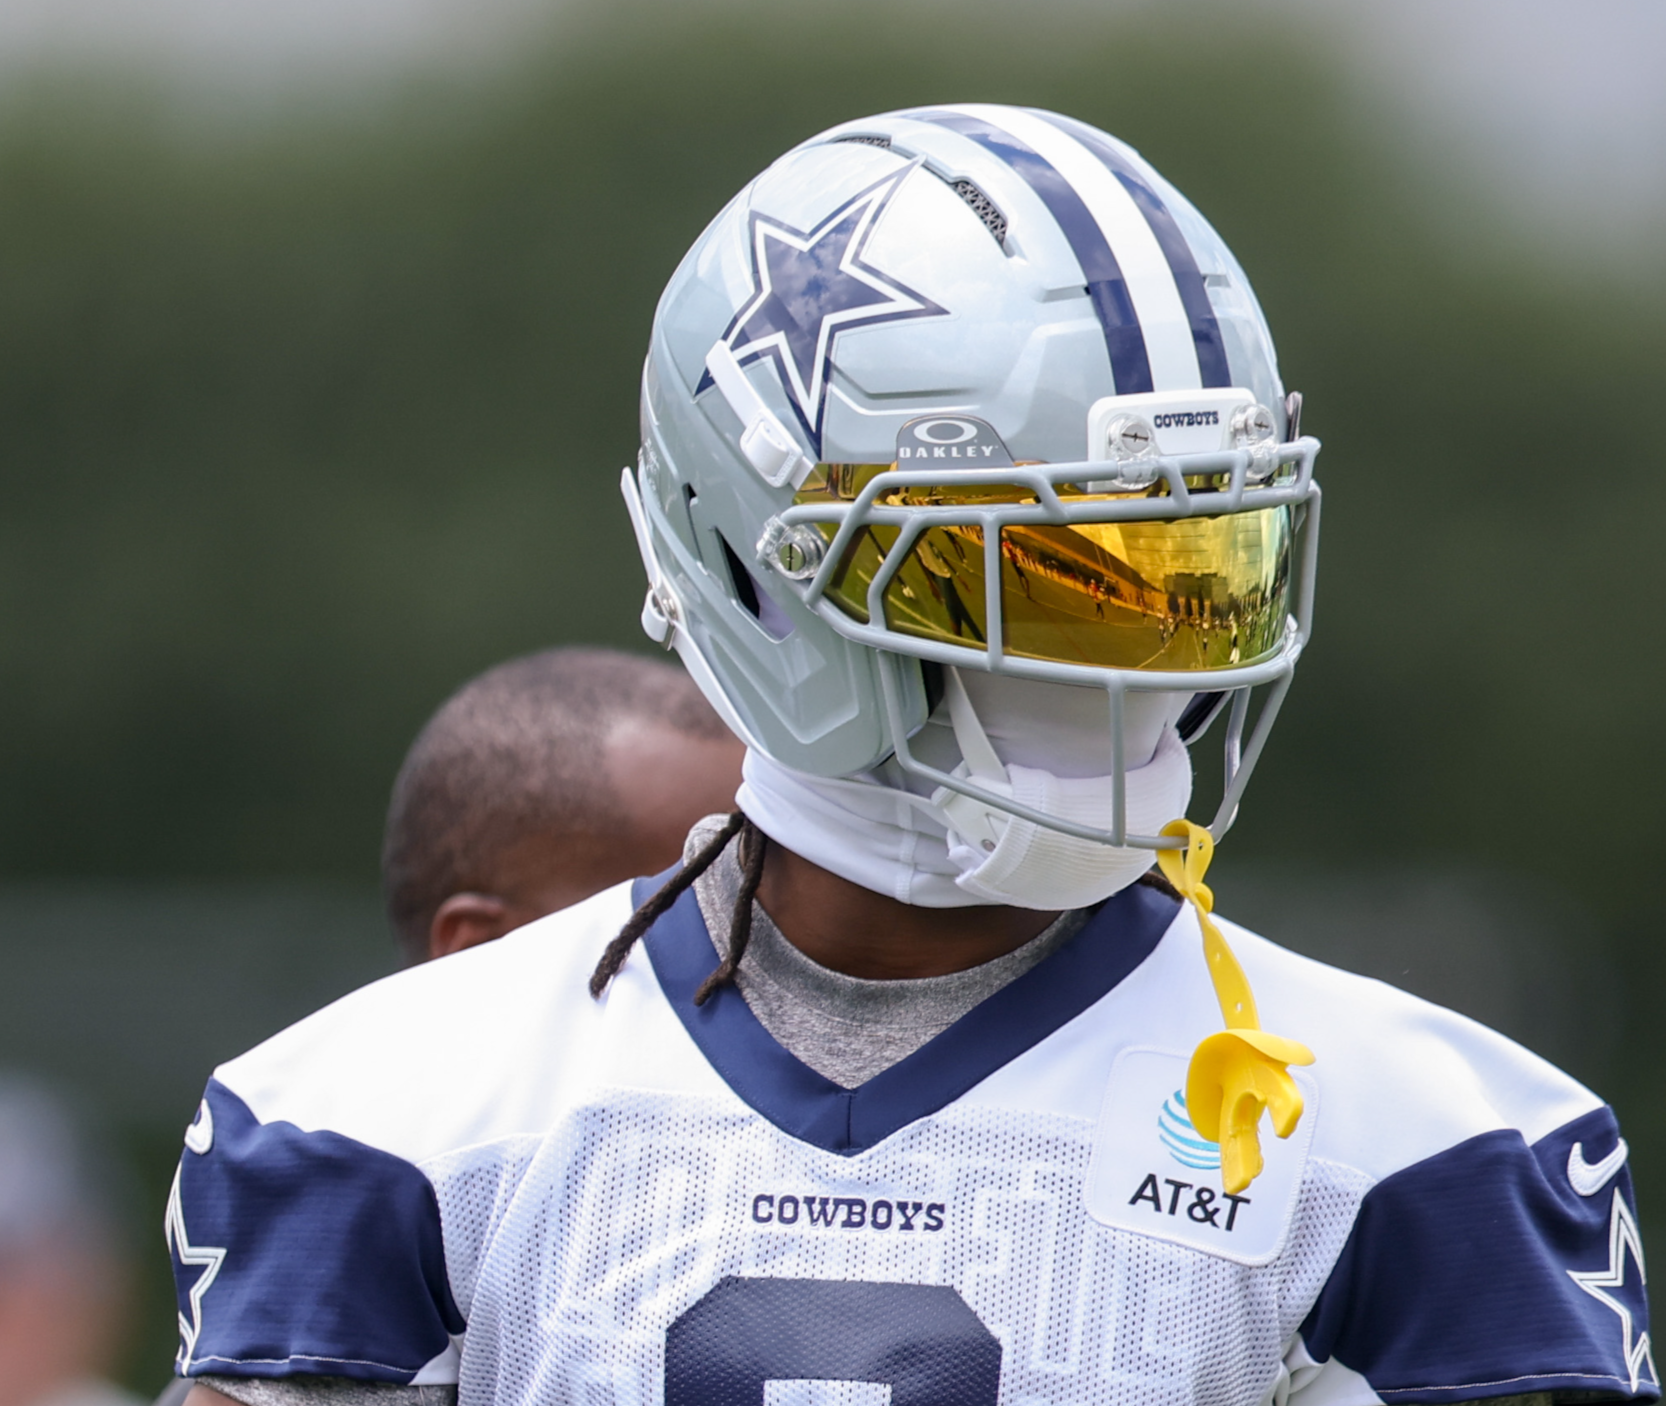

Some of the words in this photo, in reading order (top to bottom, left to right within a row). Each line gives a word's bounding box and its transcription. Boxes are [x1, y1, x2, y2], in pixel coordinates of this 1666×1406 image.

[1154, 411, 1219, 429] COWBOYS
[898, 445, 993, 459] OAKLEY
[752, 1193, 946, 1233] COWBOYS
[1128, 1173, 1251, 1232] AT&T
